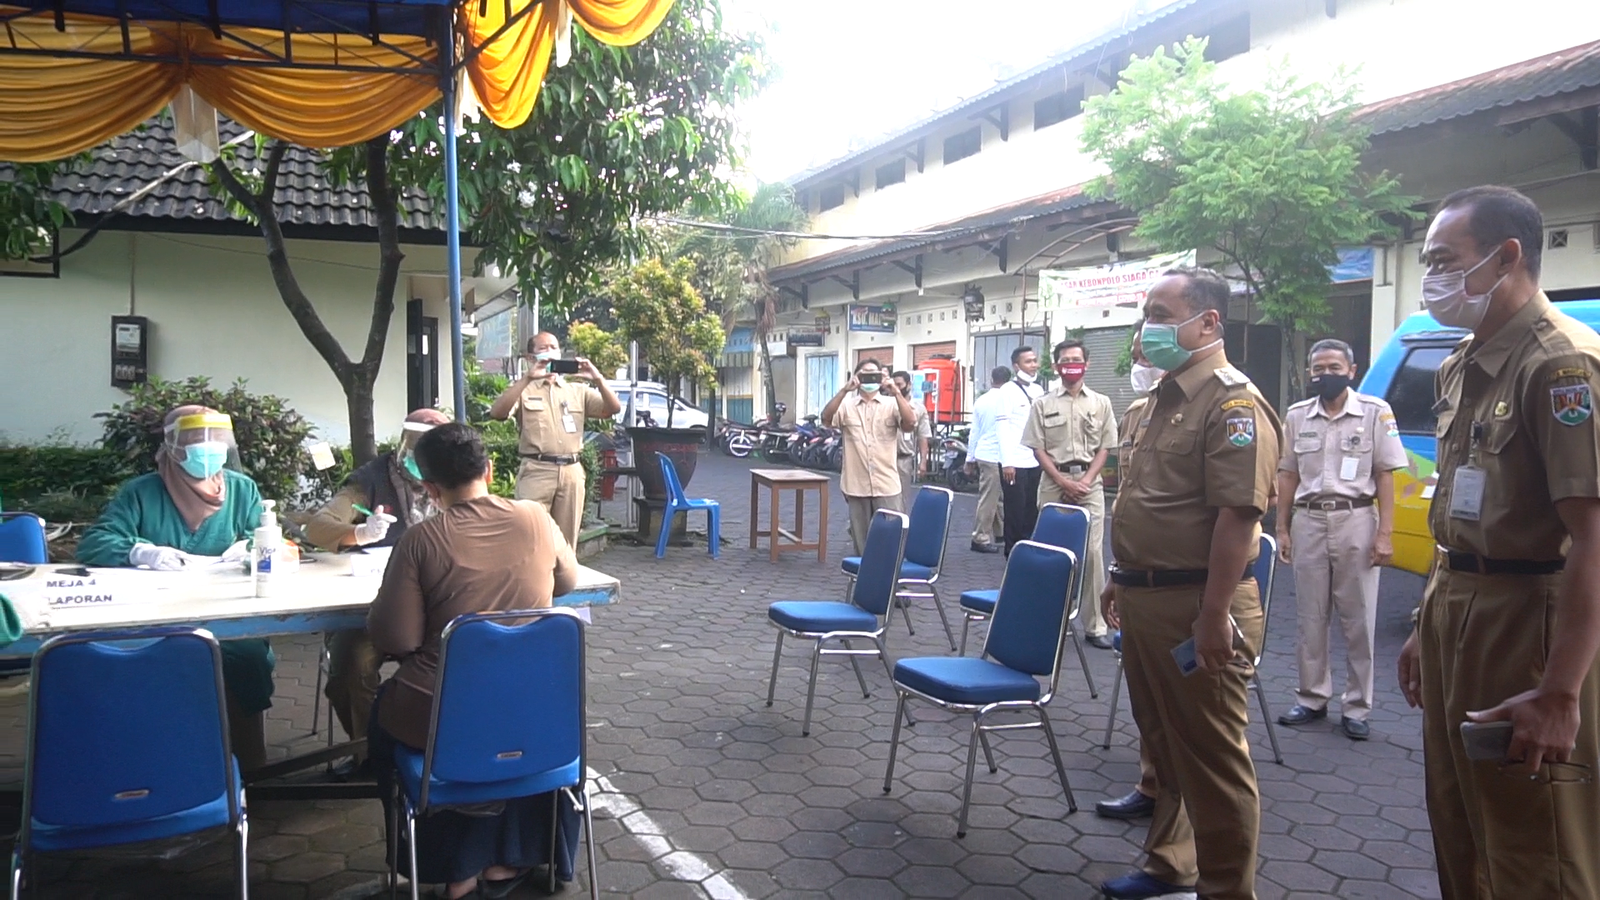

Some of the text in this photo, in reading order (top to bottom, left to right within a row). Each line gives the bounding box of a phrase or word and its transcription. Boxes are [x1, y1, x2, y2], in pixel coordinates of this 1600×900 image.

[1078, 275, 1121, 288] KEBONPOLO
[1122, 271, 1147, 283] SIAGA
[46, 579, 85, 588] MEJA
[48, 594, 113, 605] LAPORAN
